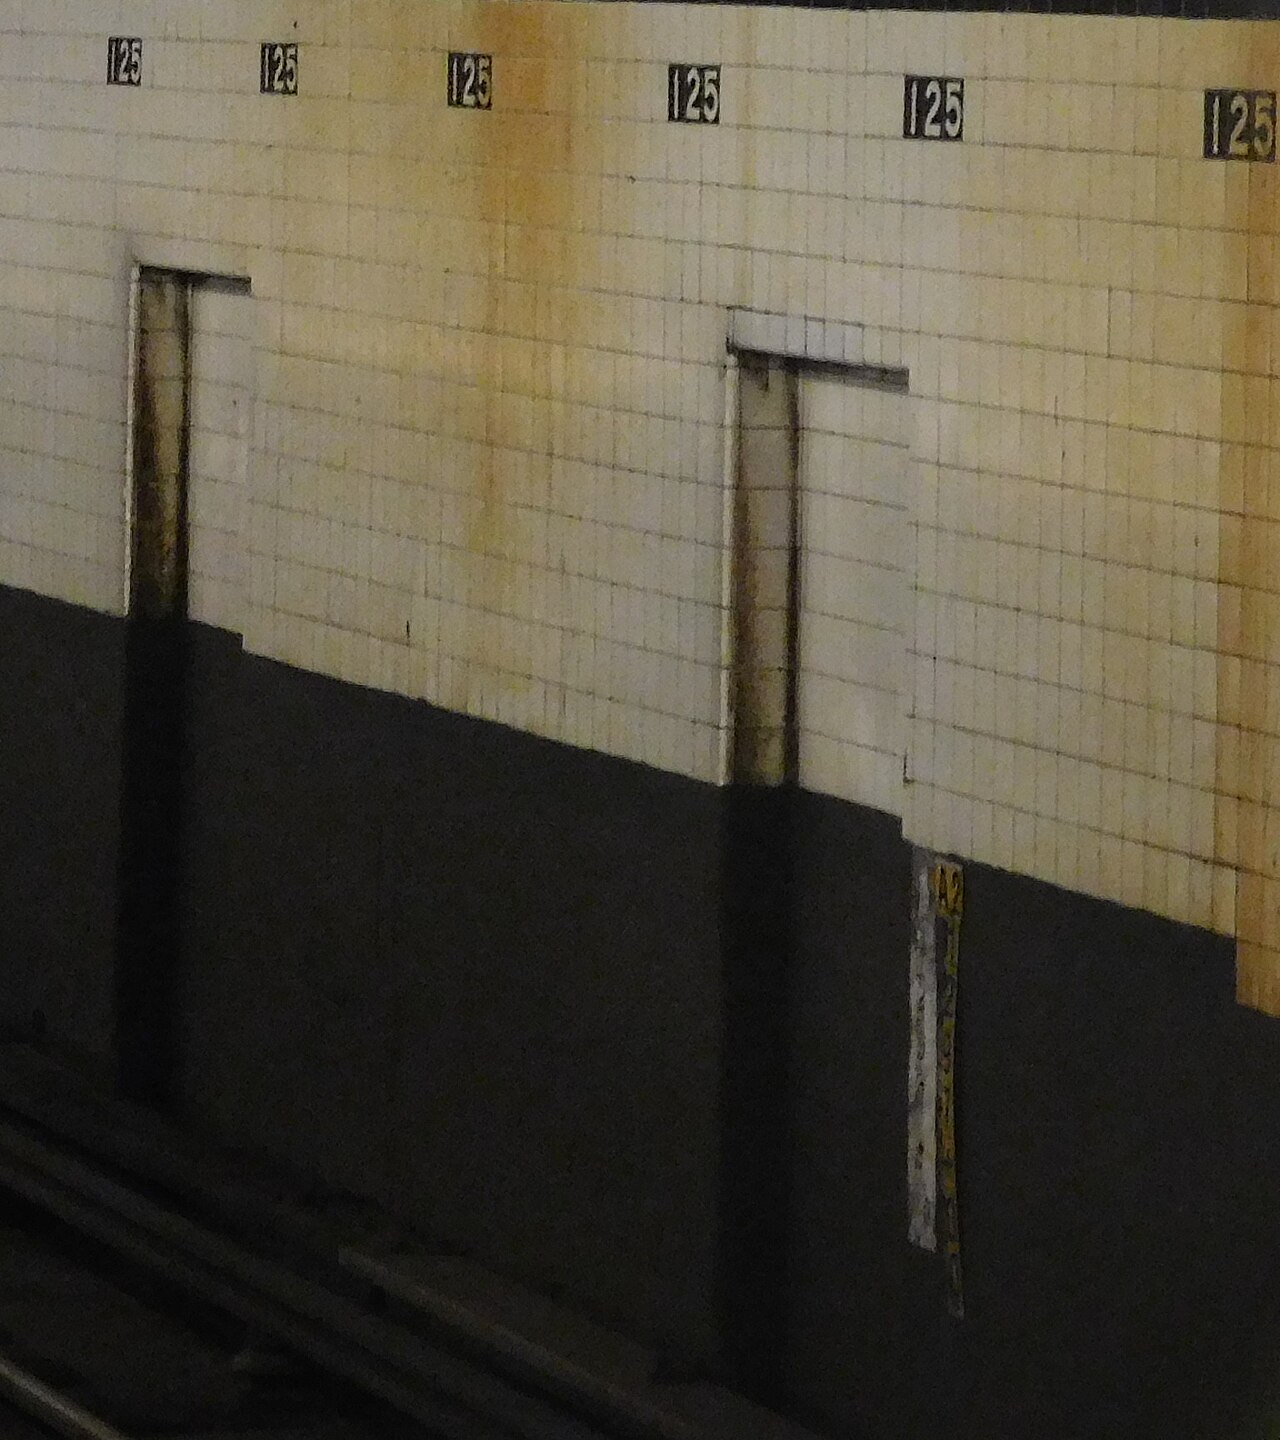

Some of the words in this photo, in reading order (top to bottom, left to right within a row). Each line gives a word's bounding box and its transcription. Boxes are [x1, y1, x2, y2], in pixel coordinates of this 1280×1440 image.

[110, 39, 142, 83] 125
[263, 46, 297, 91] 125
[451, 58, 490, 106] 125
[673, 68, 719, 122] 125
[909, 80, 961, 137] 125
[1211, 95, 1273, 156] 125
